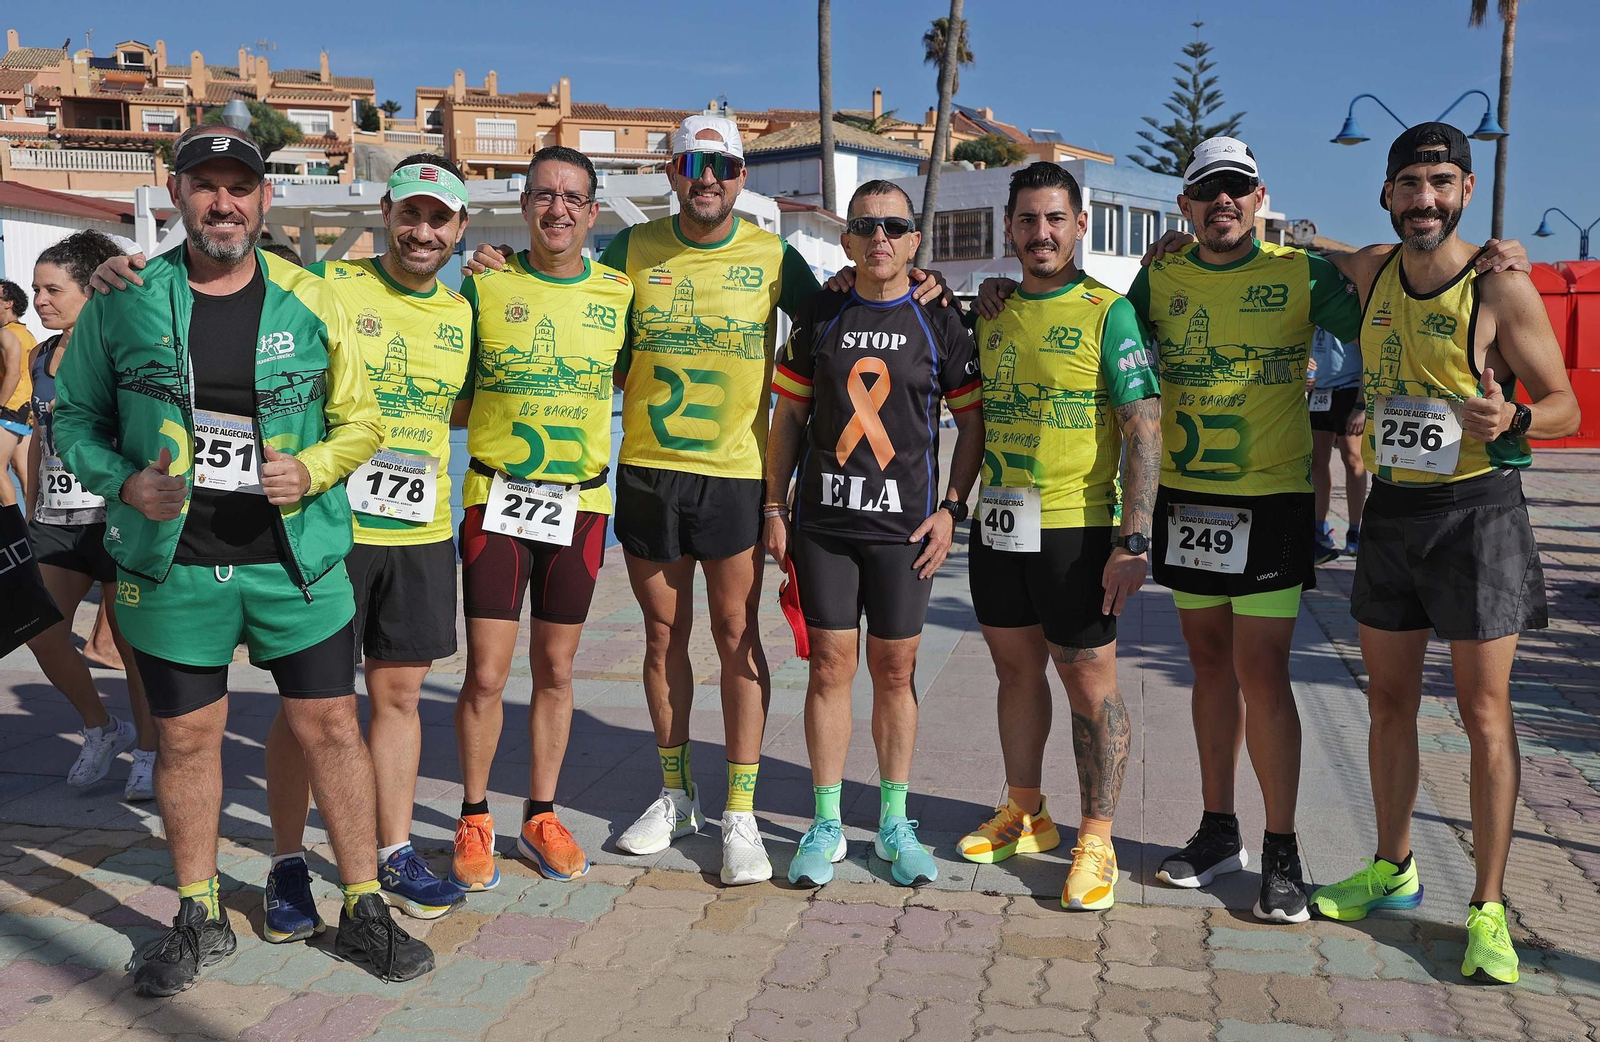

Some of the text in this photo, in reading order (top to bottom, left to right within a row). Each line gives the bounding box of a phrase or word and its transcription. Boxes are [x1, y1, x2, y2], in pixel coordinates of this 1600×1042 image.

[841, 331, 907, 350] STOP
[257, 355, 277, 365] RUNNERS
[1179, 392, 1247, 408] LOS BARRIOS
[1414, 403, 1446, 413] URBANA
[519, 401, 588, 420] LOS BARRIOS
[1412, 410, 1446, 421] ALGECIRAS
[209, 426, 219, 435] DE
[220, 429, 256, 440] ALGECIRAS
[390, 425, 434, 443] BARRIOS
[986, 428, 1041, 449] LOS BARRIOS
[1381, 419, 1444, 452] 256
[195, 435, 254, 472] 251
[370, 459, 393, 470] CIUDAD
[366, 471, 424, 503] 178
[507, 482, 528, 493] CIUDAD
[535, 488, 563, 500] ALGECIRAS
[820, 472, 903, 513] ELA
[501, 493, 562, 526] 272
[1205, 511, 1234, 520] URBANA
[985, 507, 1015, 533] 40
[1180, 515, 1197, 524] CIUDAD
[1204, 519, 1234, 527] ALGECIRAS
[1179, 525, 1234, 554] 249
